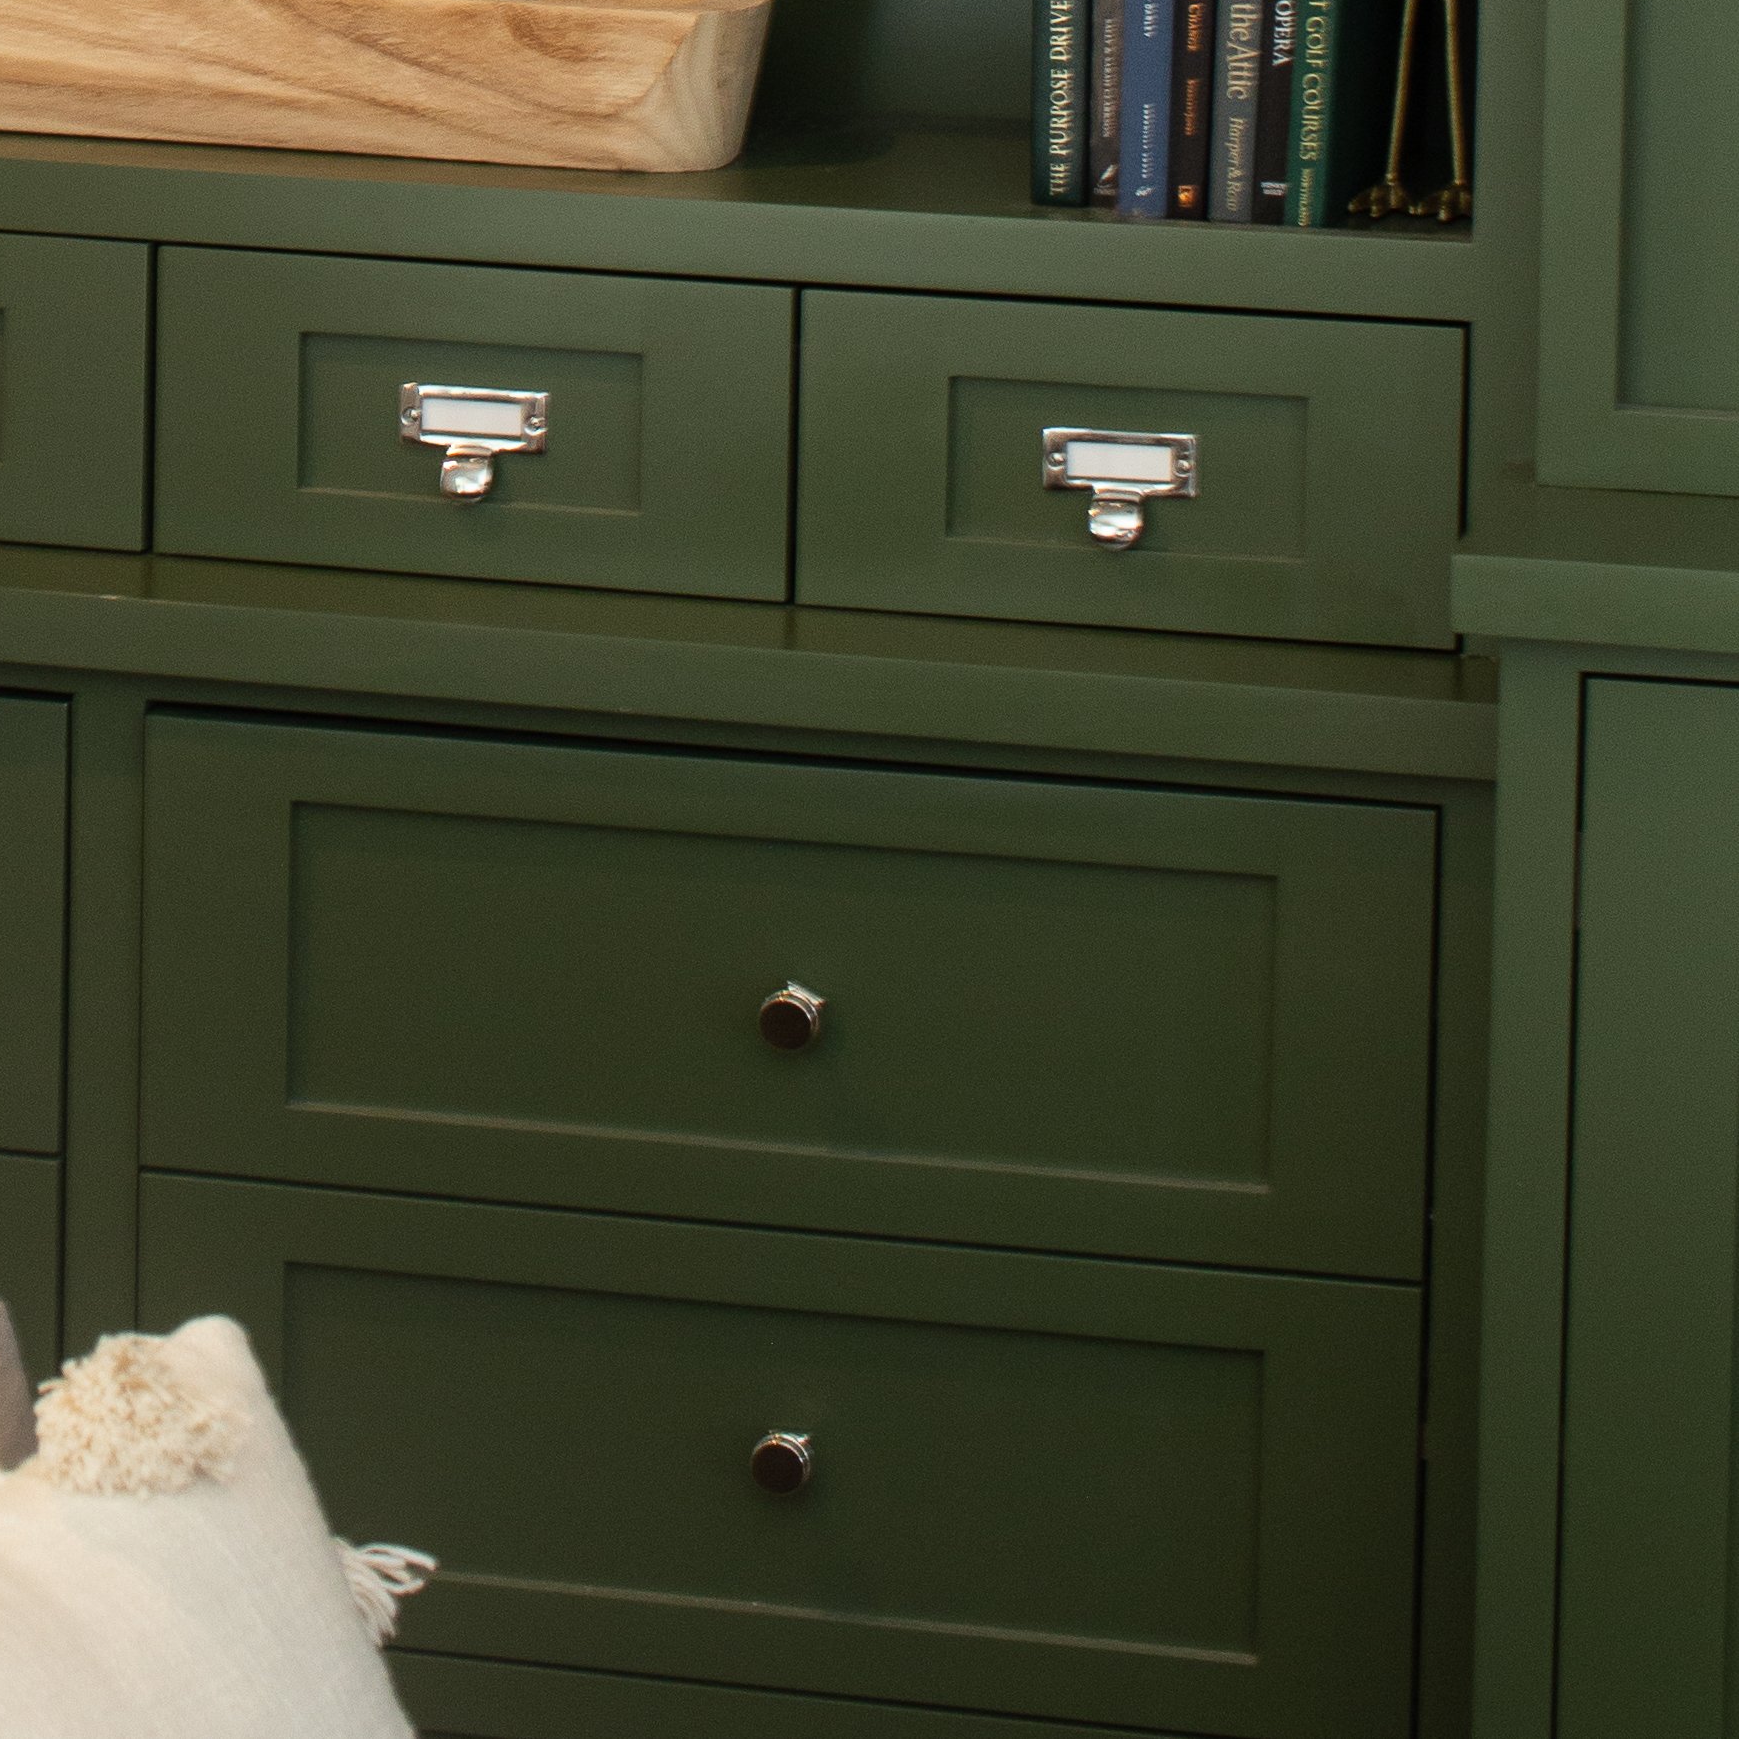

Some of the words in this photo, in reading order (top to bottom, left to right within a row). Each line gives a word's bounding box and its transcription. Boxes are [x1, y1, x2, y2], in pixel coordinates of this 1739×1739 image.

[1228, 4, 1259, 40] the
[1272, 0, 1297, 67] OPERA
[1305, 15, 1329, 68] GOLF
[1226, 41, 1260, 100] Attic
[1049, 68, 1072, 156] PURPOSE
[1298, 72, 1324, 161] COURSES
[1049, 164, 1070, 196] THE
